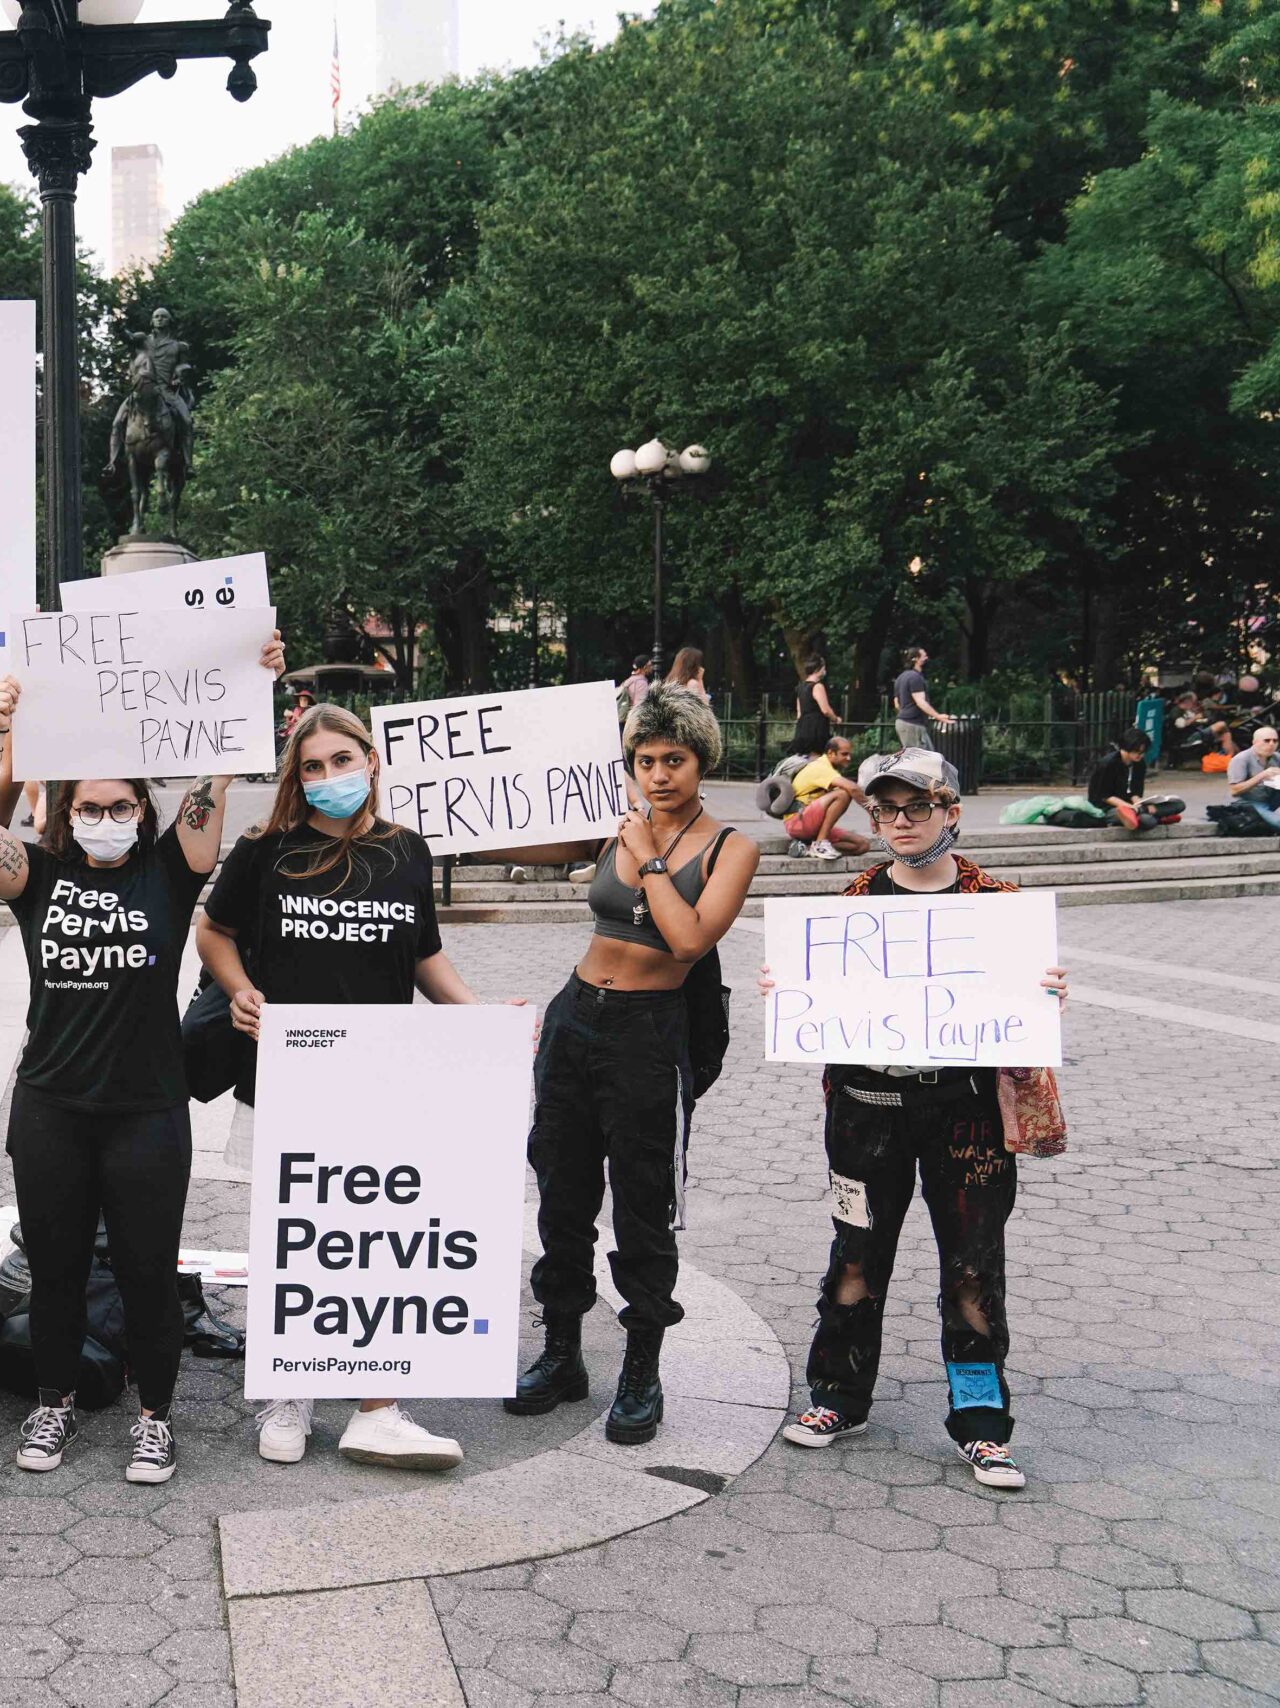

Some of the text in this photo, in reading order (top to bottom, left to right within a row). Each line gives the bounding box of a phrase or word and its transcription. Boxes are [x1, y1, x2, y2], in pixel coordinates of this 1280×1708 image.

[22, 612, 143, 667] FREE
[98, 668, 227, 713] PERVIS
[139, 718, 247, 764] PAYNE
[384, 705, 511, 765] FREE
[389, 758, 626, 839] PERVIS PAYNE
[51, 879, 119, 911] Free
[278, 894, 415, 924] INNOCENCE
[42, 905, 149, 938] Pervis
[281, 918, 394, 943] PROJECT
[41, 939, 157, 977] Payne.
[805, 907, 986, 981] FREE
[44, 979, 109, 990] PervisPayne.org
[284, 1029, 347, 1038] INNOCENCE
[773, 985, 1028, 1061] Pervis Payne
[285, 1038, 335, 1048] PROJECT
[948, 1144, 997, 1160] WALK
[278, 1152, 421, 1205] Free
[965, 1172, 988, 1185] ME
[275, 1217, 478, 1271] Pervis
[273, 1283, 489, 1348] Payne.
[272, 1357, 411, 1375] PervisPayne.org
